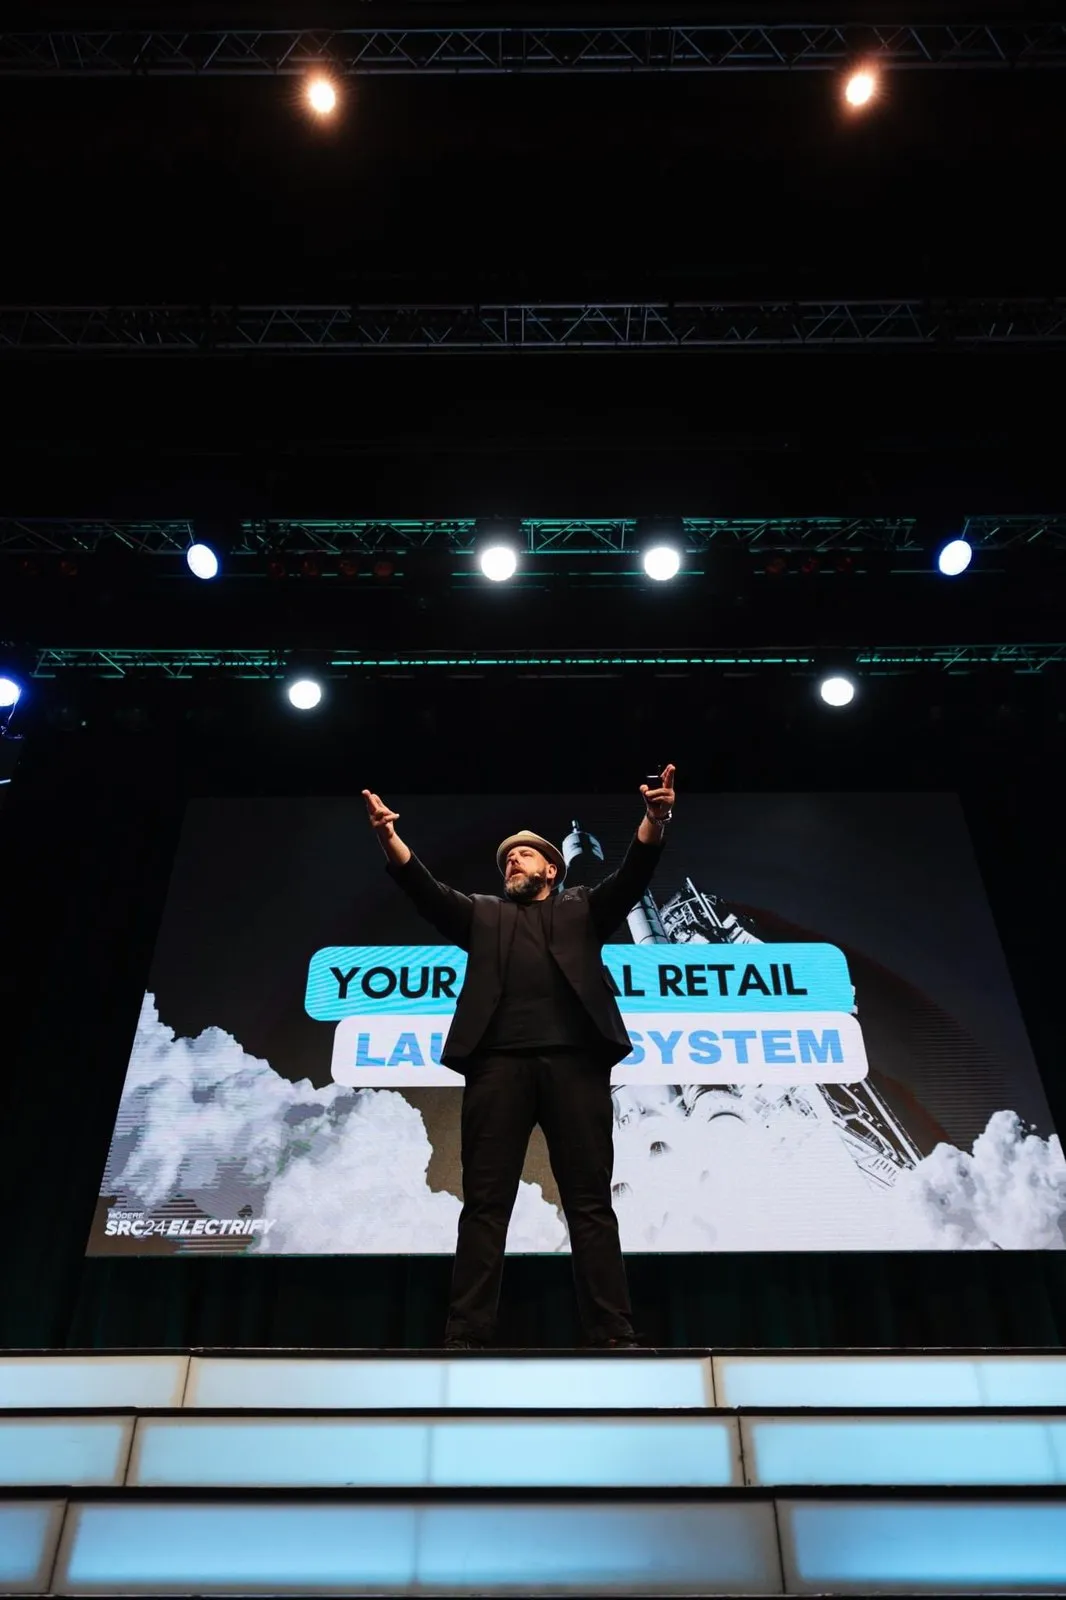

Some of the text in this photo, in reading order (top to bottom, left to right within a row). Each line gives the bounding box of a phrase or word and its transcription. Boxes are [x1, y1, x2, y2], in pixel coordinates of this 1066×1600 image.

[329, 966, 458, 999] YOUR
[657, 963, 809, 997] RETAIL
[621, 1029, 845, 1066] SYSTEM
